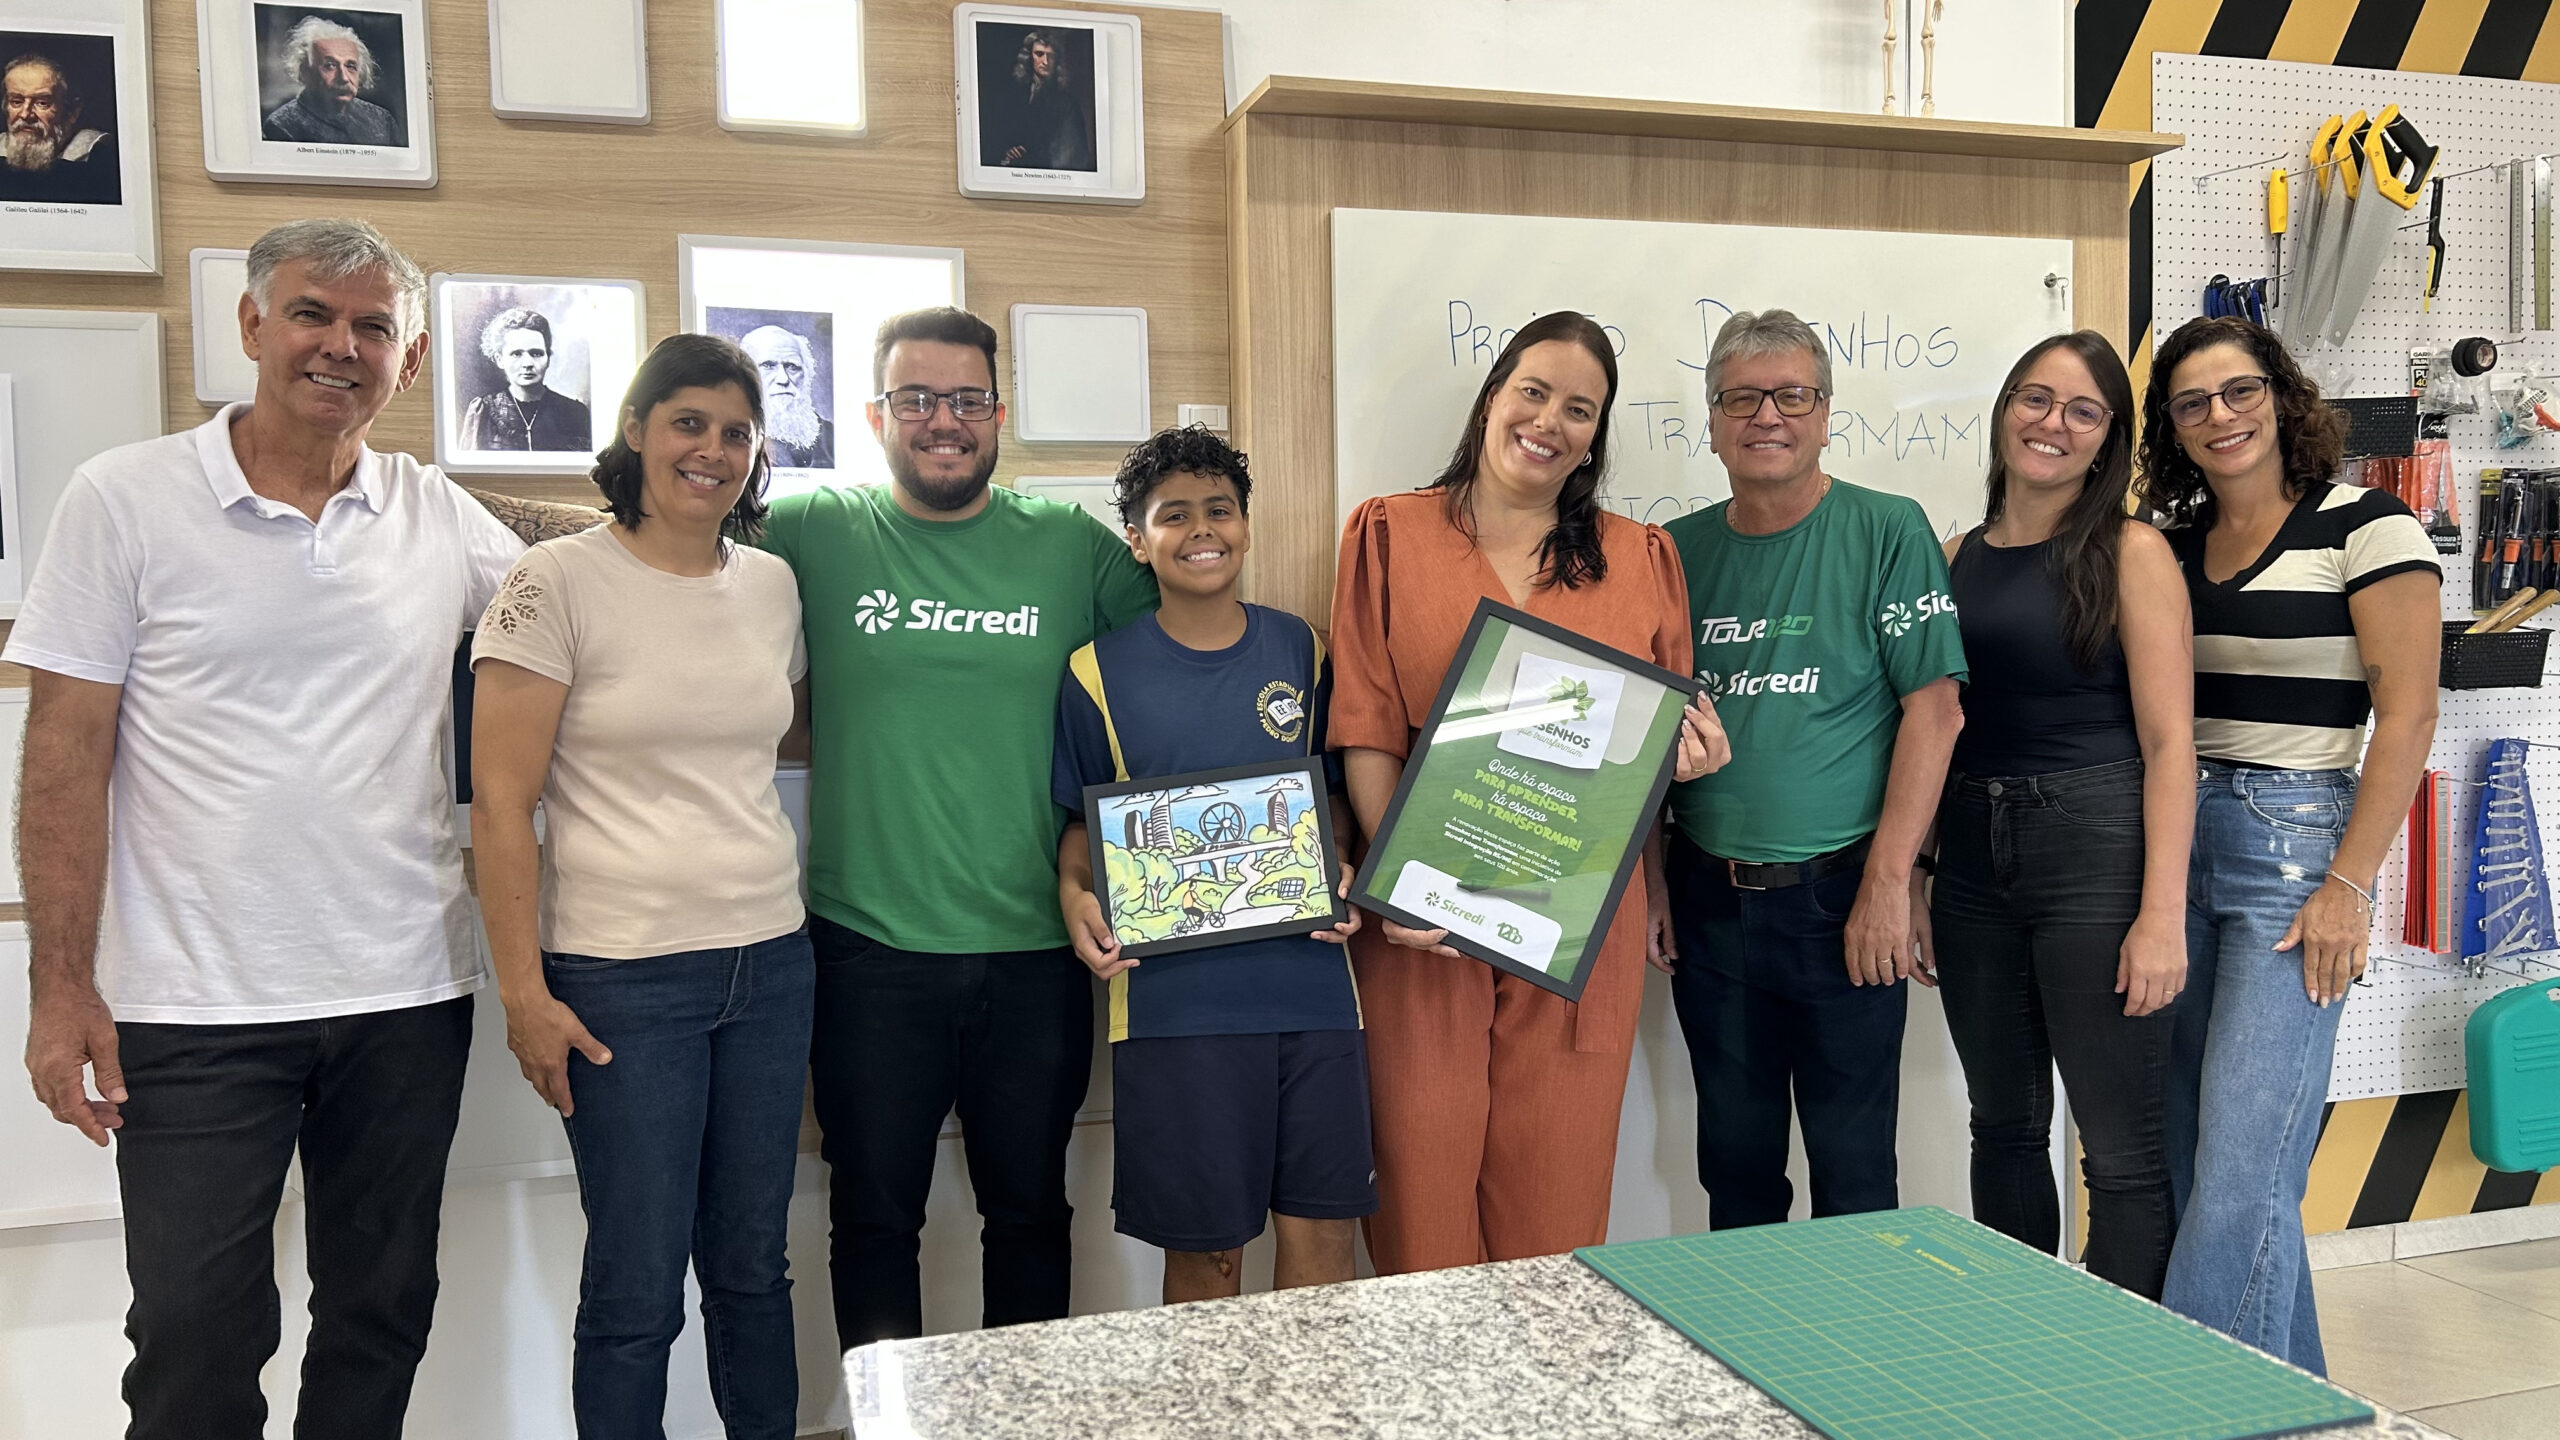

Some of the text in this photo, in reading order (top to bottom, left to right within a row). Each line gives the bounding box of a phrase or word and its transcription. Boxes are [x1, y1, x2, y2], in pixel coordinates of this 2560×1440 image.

[28, 206, 49, 214] Galilei
[50, 207, 88, 215] (1564-1642)
[904, 598, 1040, 637] Sicredi
[1256, 681, 1298, 711] ESCOLA ESTADUAL
[1726, 667, 1821, 697] Sicredi
[1275, 704, 1287, 715] EE
[1260, 718, 1279, 739] PEDRO
[1532, 731, 1584, 758] transformam
[1474, 769, 1578, 823] PARA APRENDER,
[1488, 759, 1577, 804] Onde há espaço
[1452, 789, 1583, 852] PARA TRANSFORMAR!
[1490, 790, 1548, 823] há espaço
[1444, 822, 1472, 837] Desenhos
[1531, 858, 1554, 873] iniciativa
[1444, 830, 1464, 843] Sicredi
[1463, 838, 1493, 855] Integração
[1520, 864, 1557, 883] comemoração
[1457, 819, 1483, 833] renovação
[1483, 830, 1498, 840] deste
[1498, 837, 1517, 848] espaço
[1525, 848, 1541, 858] parte
[1547, 857, 1561, 867] ação
[1483, 858, 1496, 866] seus
[1440, 899, 1486, 926] Sicredi
